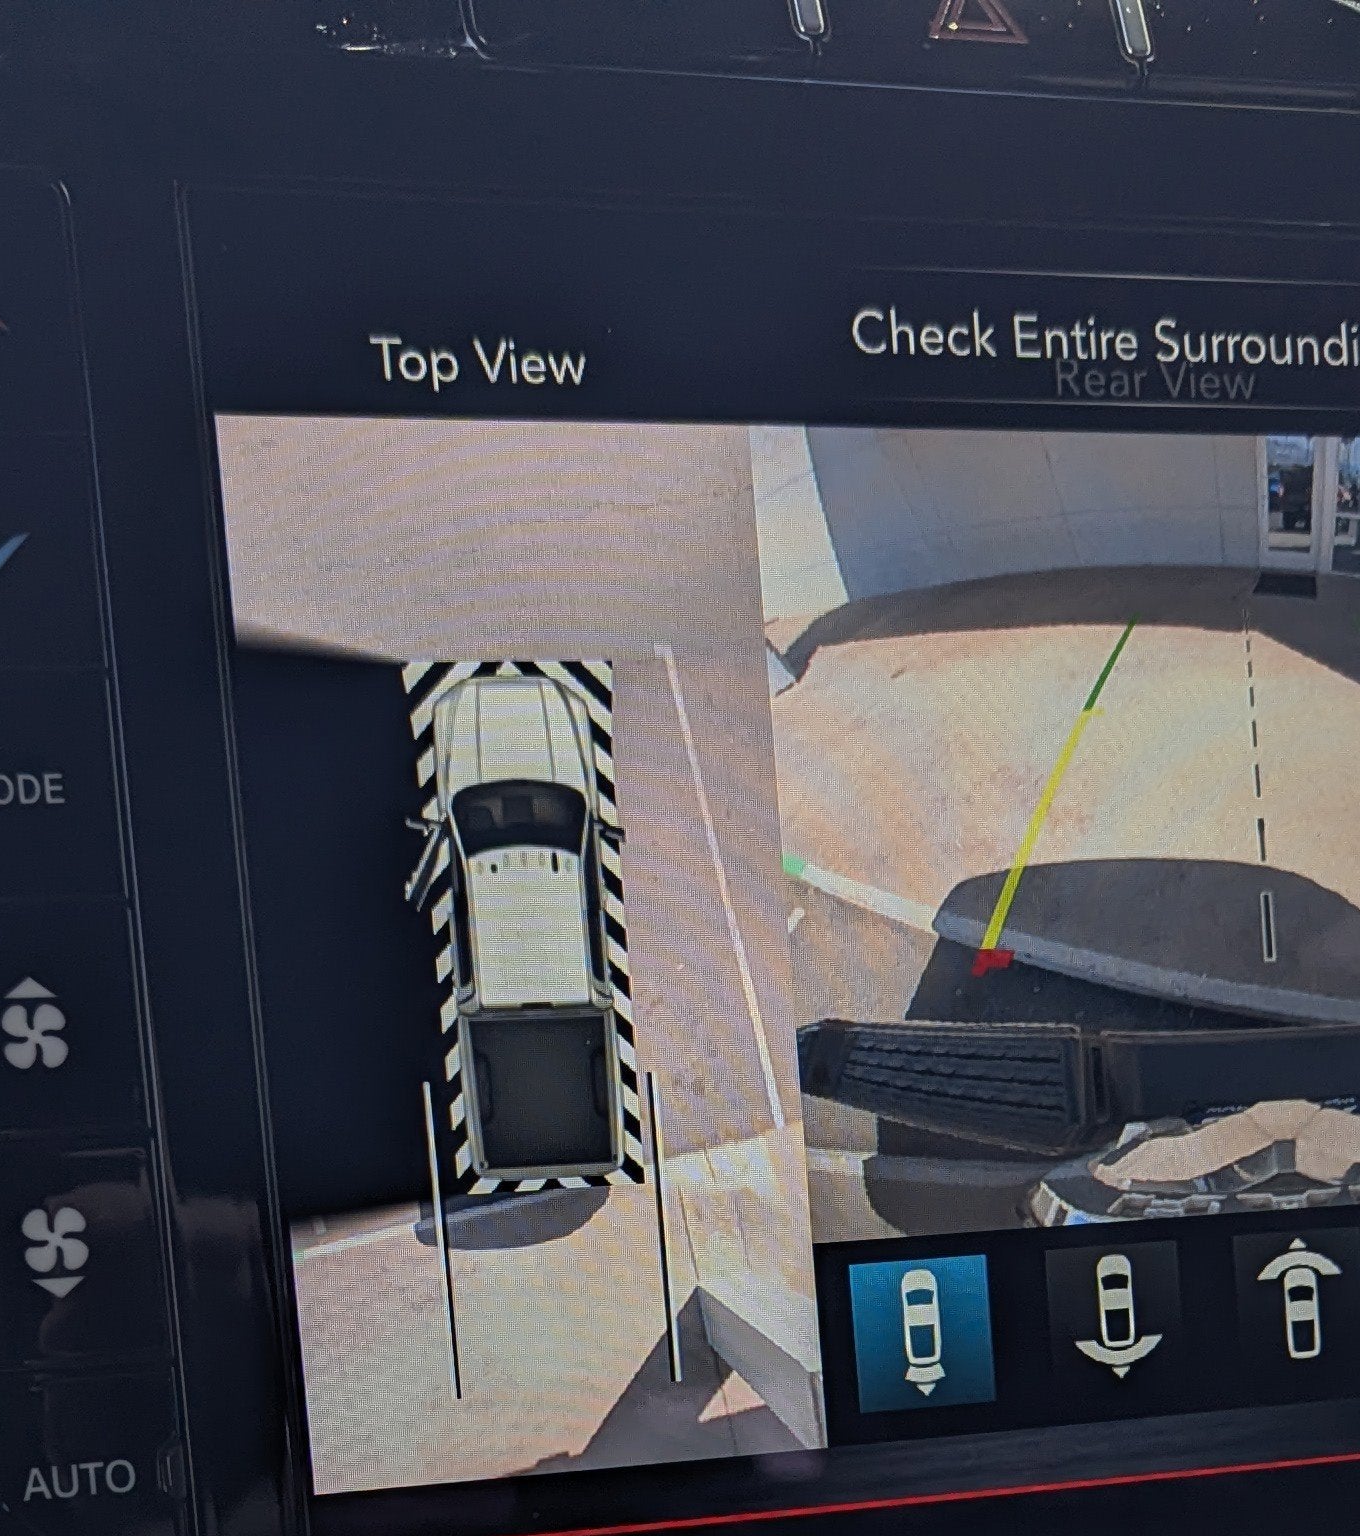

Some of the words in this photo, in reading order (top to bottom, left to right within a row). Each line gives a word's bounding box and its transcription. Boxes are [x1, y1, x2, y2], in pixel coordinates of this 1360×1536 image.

[851, 306, 997, 358] Check
[1014, 312, 1139, 361] Entire
[369, 336, 459, 392] Top
[474, 337, 586, 386] View
[1054, 359, 1146, 399] Rear
[1160, 362, 1256, 400] View
[23, 1458, 136, 1501] AUTO
